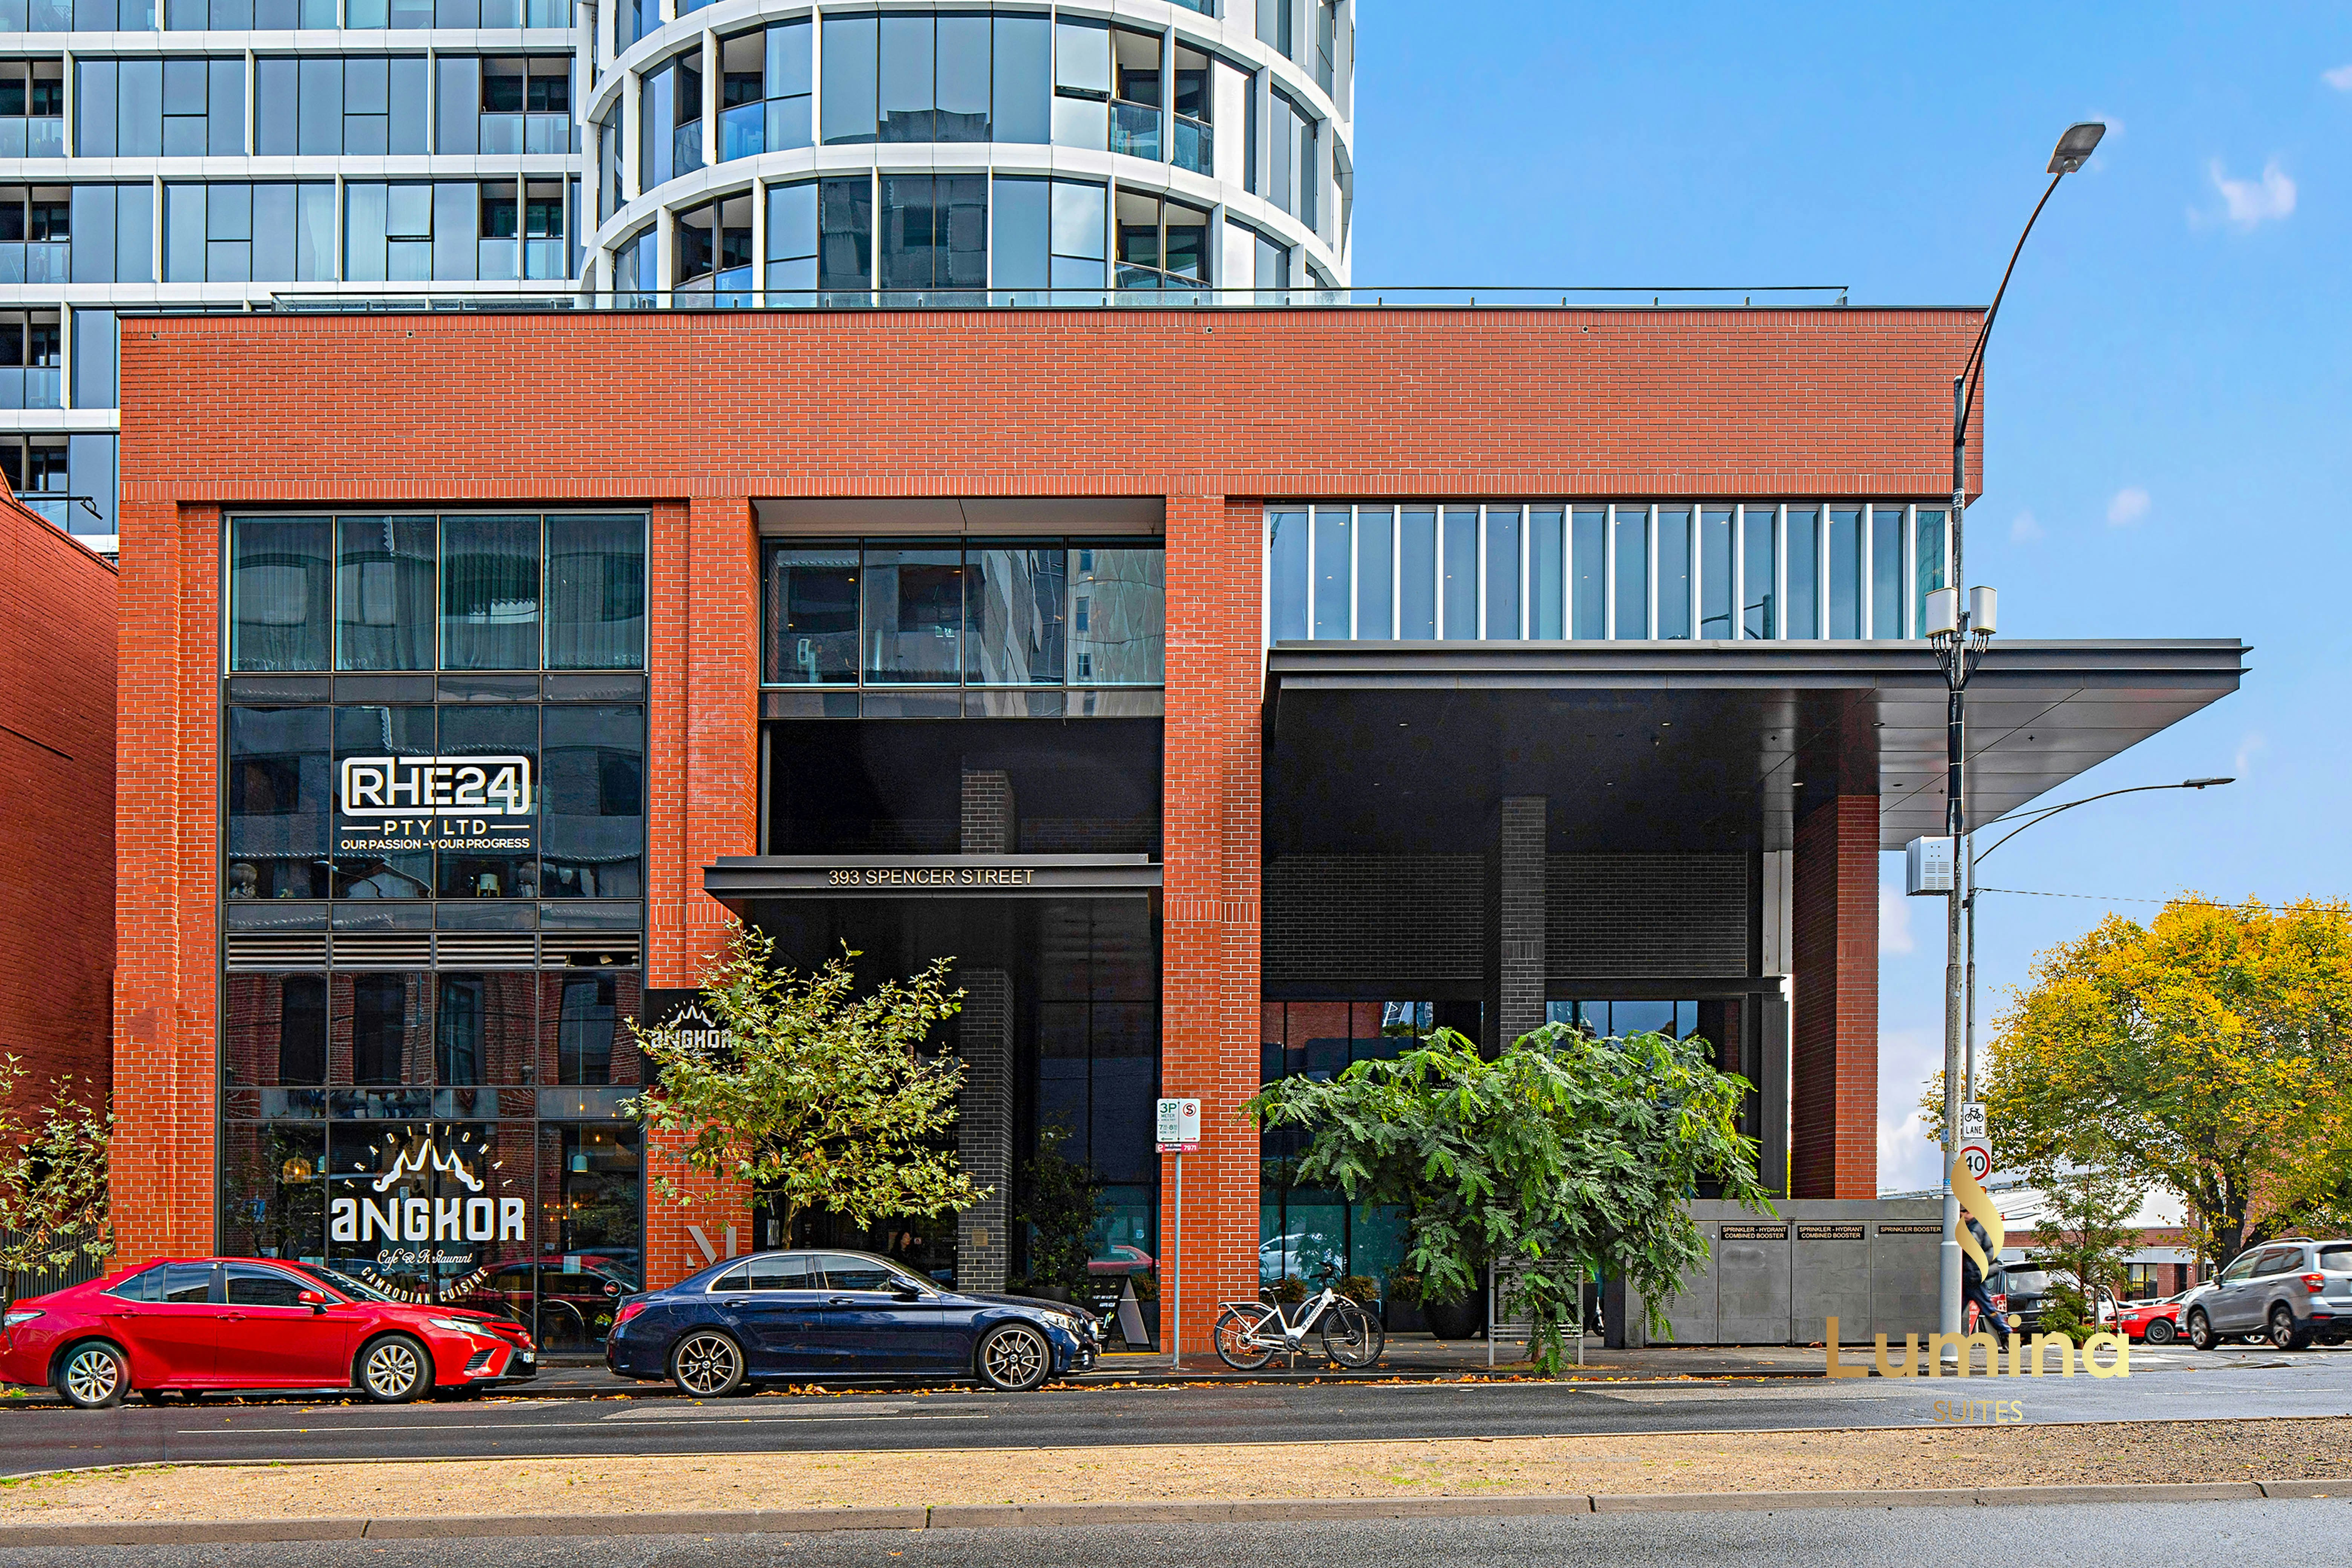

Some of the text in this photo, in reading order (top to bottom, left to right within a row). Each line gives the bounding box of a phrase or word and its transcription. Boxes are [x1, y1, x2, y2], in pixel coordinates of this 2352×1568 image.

[349, 761, 522, 814] RHE24
[384, 819, 487, 835] PTY LTD
[341, 839, 367, 850] OUR
[369, 839, 421, 850] PASSION
[466, 838, 530, 848] PROGRESS
[829, 869, 1035, 885] 393 SPENCER STREET
[1160, 1103, 1177, 1113] 3P
[1966, 1125, 1983, 1134] LANE
[344, 1123, 513, 1188] TRADITIONAL
[361, 1266, 489, 1304] CAMBODIAN CUISINE
